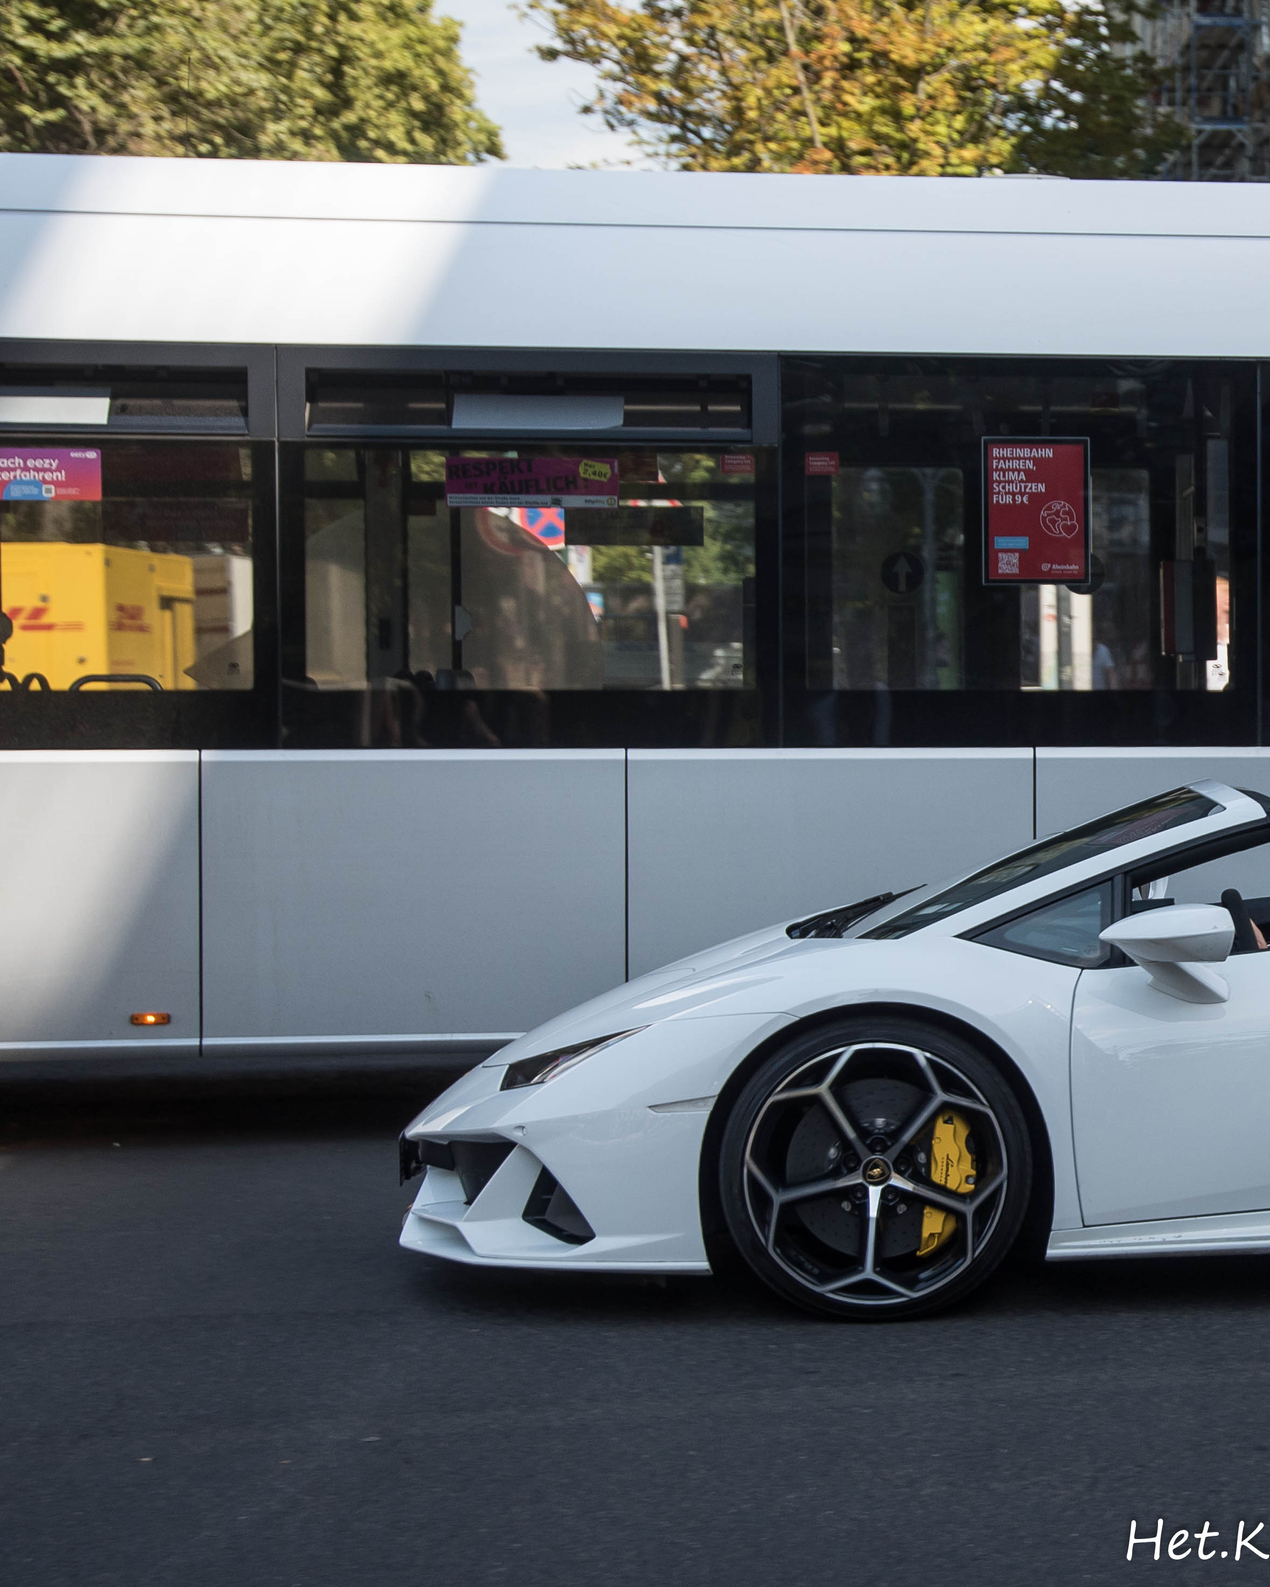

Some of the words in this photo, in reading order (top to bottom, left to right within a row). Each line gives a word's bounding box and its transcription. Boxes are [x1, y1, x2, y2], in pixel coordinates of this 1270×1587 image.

[992, 448, 1054, 458] RHEINBAHN
[26, 458, 59, 470] eezy
[448, 458, 534, 480] RESPEKT
[992, 459, 1037, 471] FAHREN,
[992, 471, 1026, 481] KLIMA
[992, 481, 1046, 492] SCHÜTZEN
[992, 492, 1013, 504] FÜR
